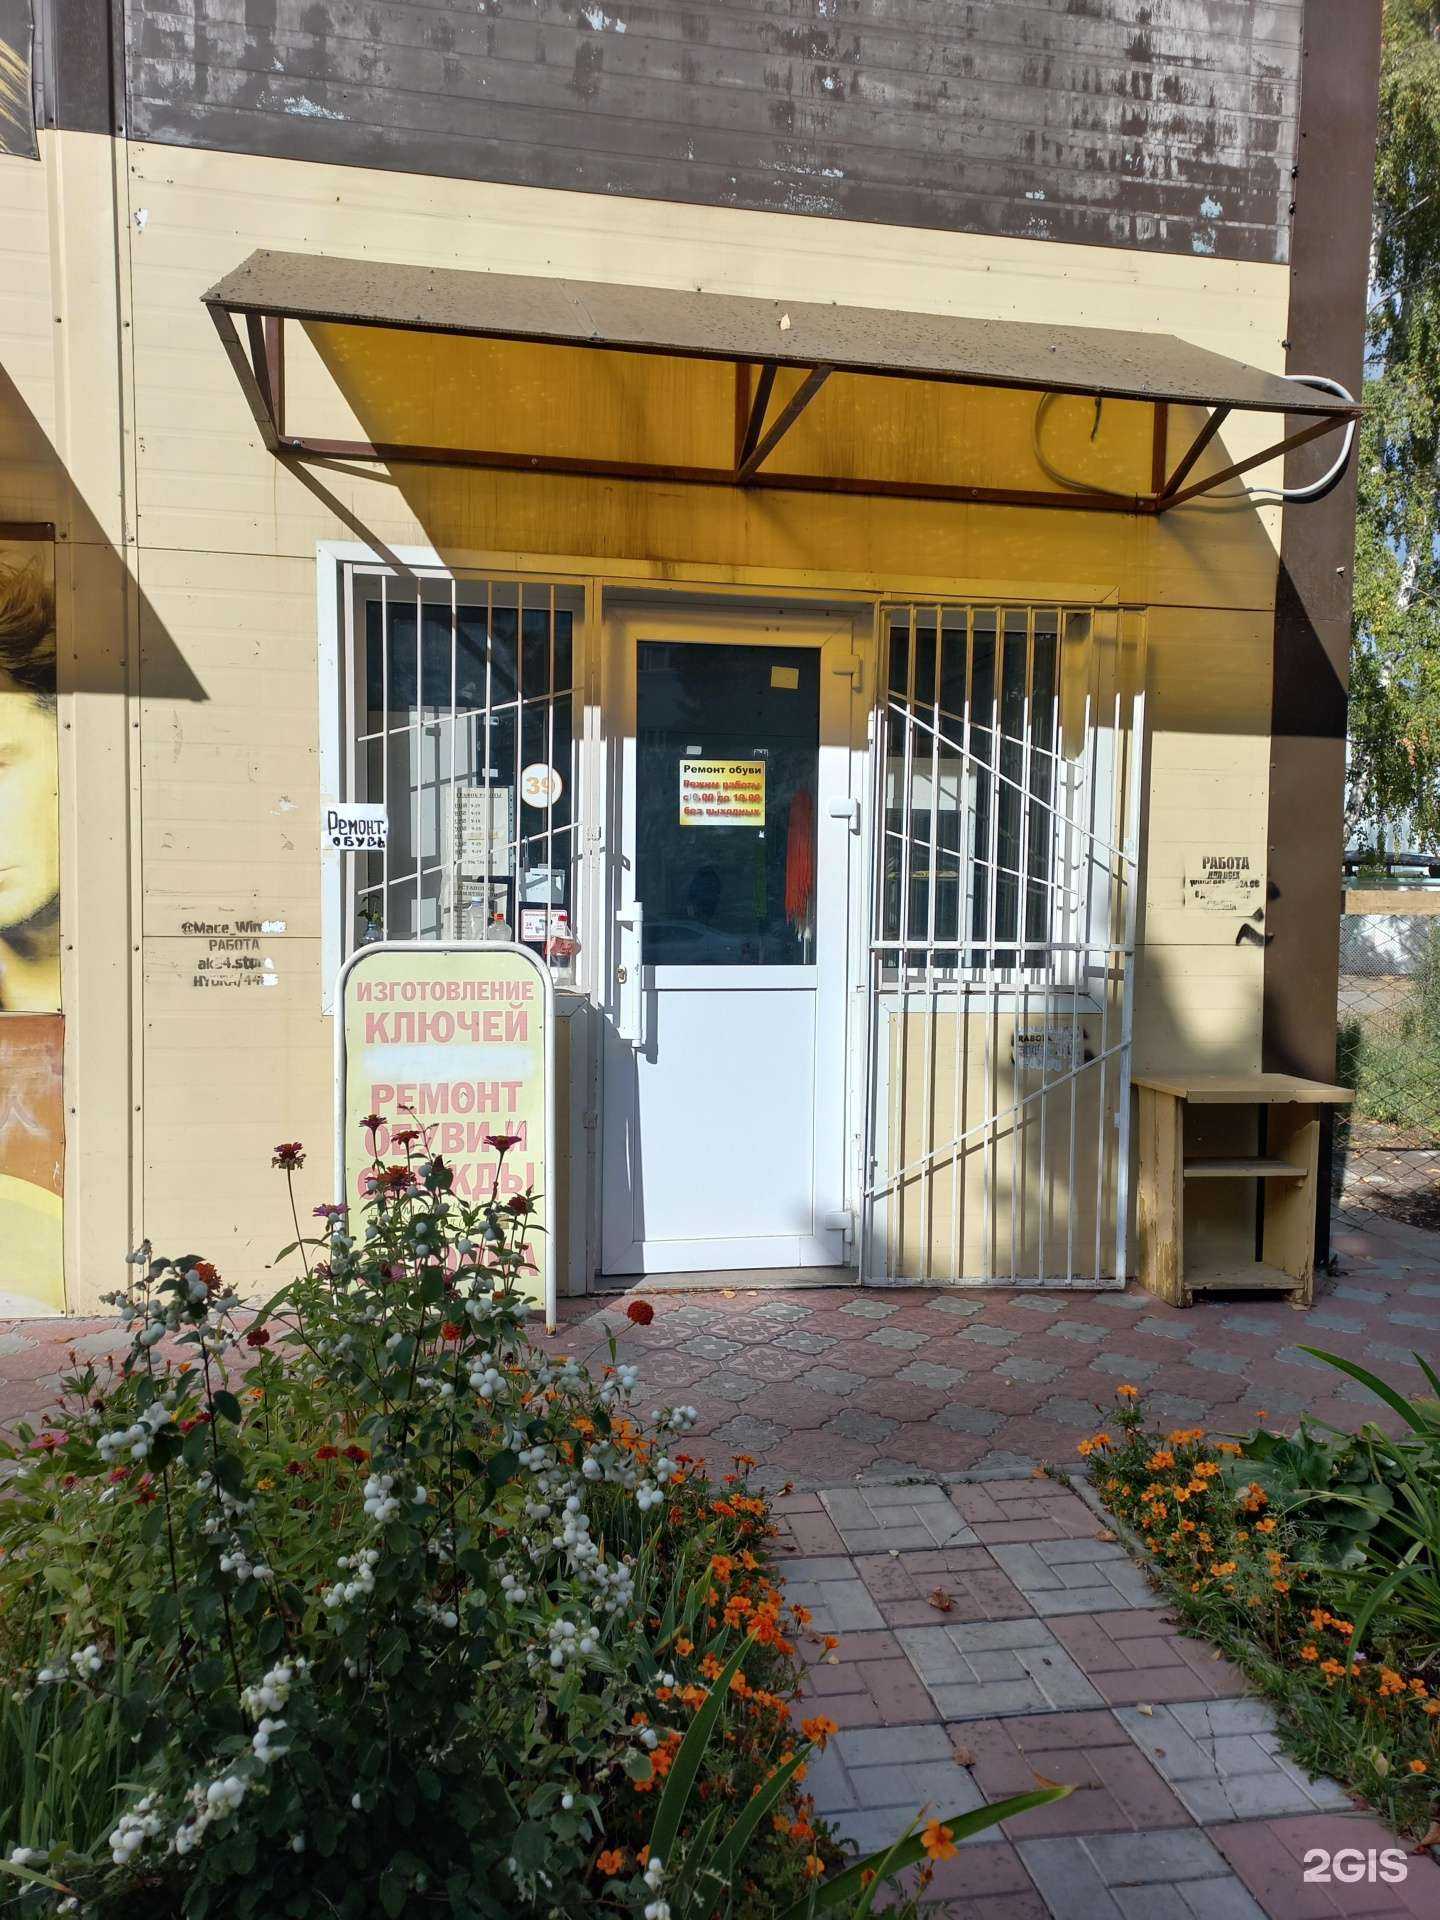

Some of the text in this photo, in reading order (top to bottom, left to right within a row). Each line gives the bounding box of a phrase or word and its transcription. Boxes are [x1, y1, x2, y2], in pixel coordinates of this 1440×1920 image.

[683, 764, 762, 776] Ремонт обуви
[1201, 855, 1250, 870] РАБОТА
[208, 938, 260, 952] РАБОТА
[356, 980, 535, 1002] ИЗГОТОВЛЕНИЕ
[364, 1002, 529, 1044] КЛЮЧЕЙ
[370, 1080, 524, 1116] РЕМОНТ
